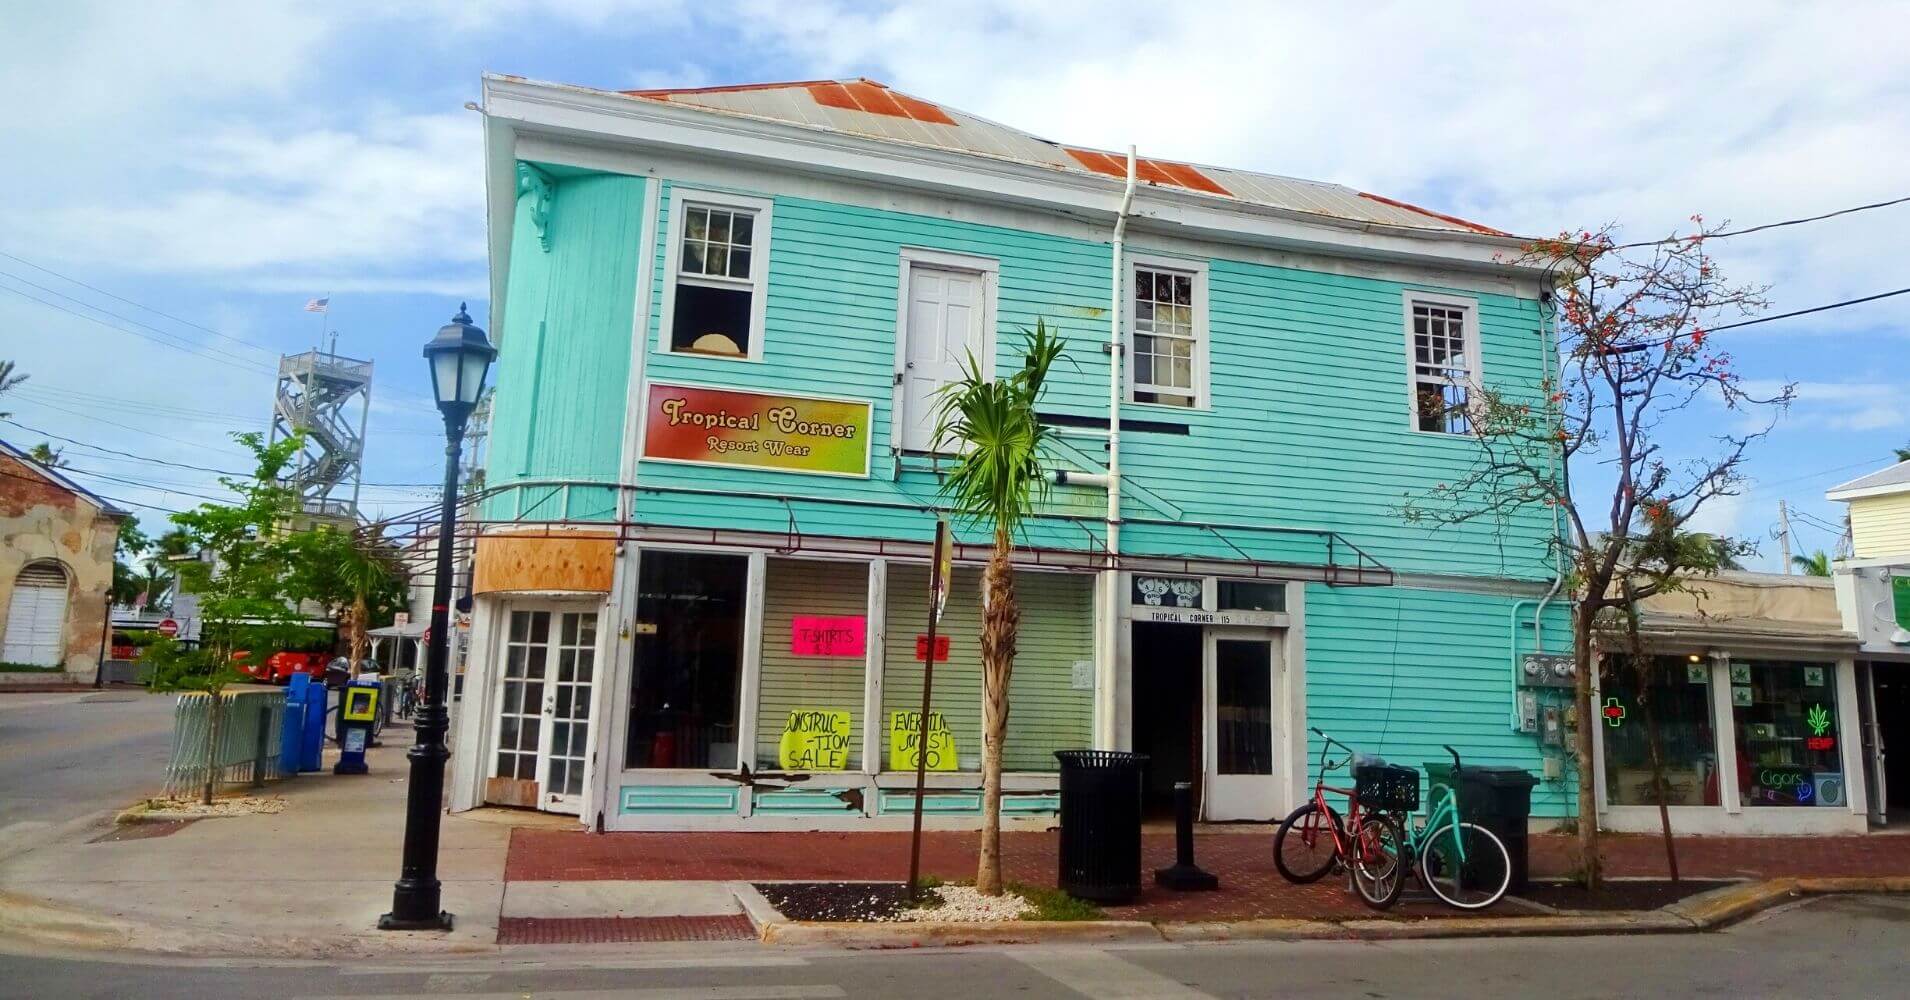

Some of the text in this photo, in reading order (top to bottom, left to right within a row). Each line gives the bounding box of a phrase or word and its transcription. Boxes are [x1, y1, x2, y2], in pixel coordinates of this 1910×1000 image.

[662, 398, 856, 438] Tropical Corner
[707, 436, 810, 456] Resort Wear
[1152, 612, 1182, 622] TROPICAL
[1189, 614, 1214, 623] CORNER
[788, 748, 843, 769] SALE
[1760, 769, 1802, 790] Cigars
